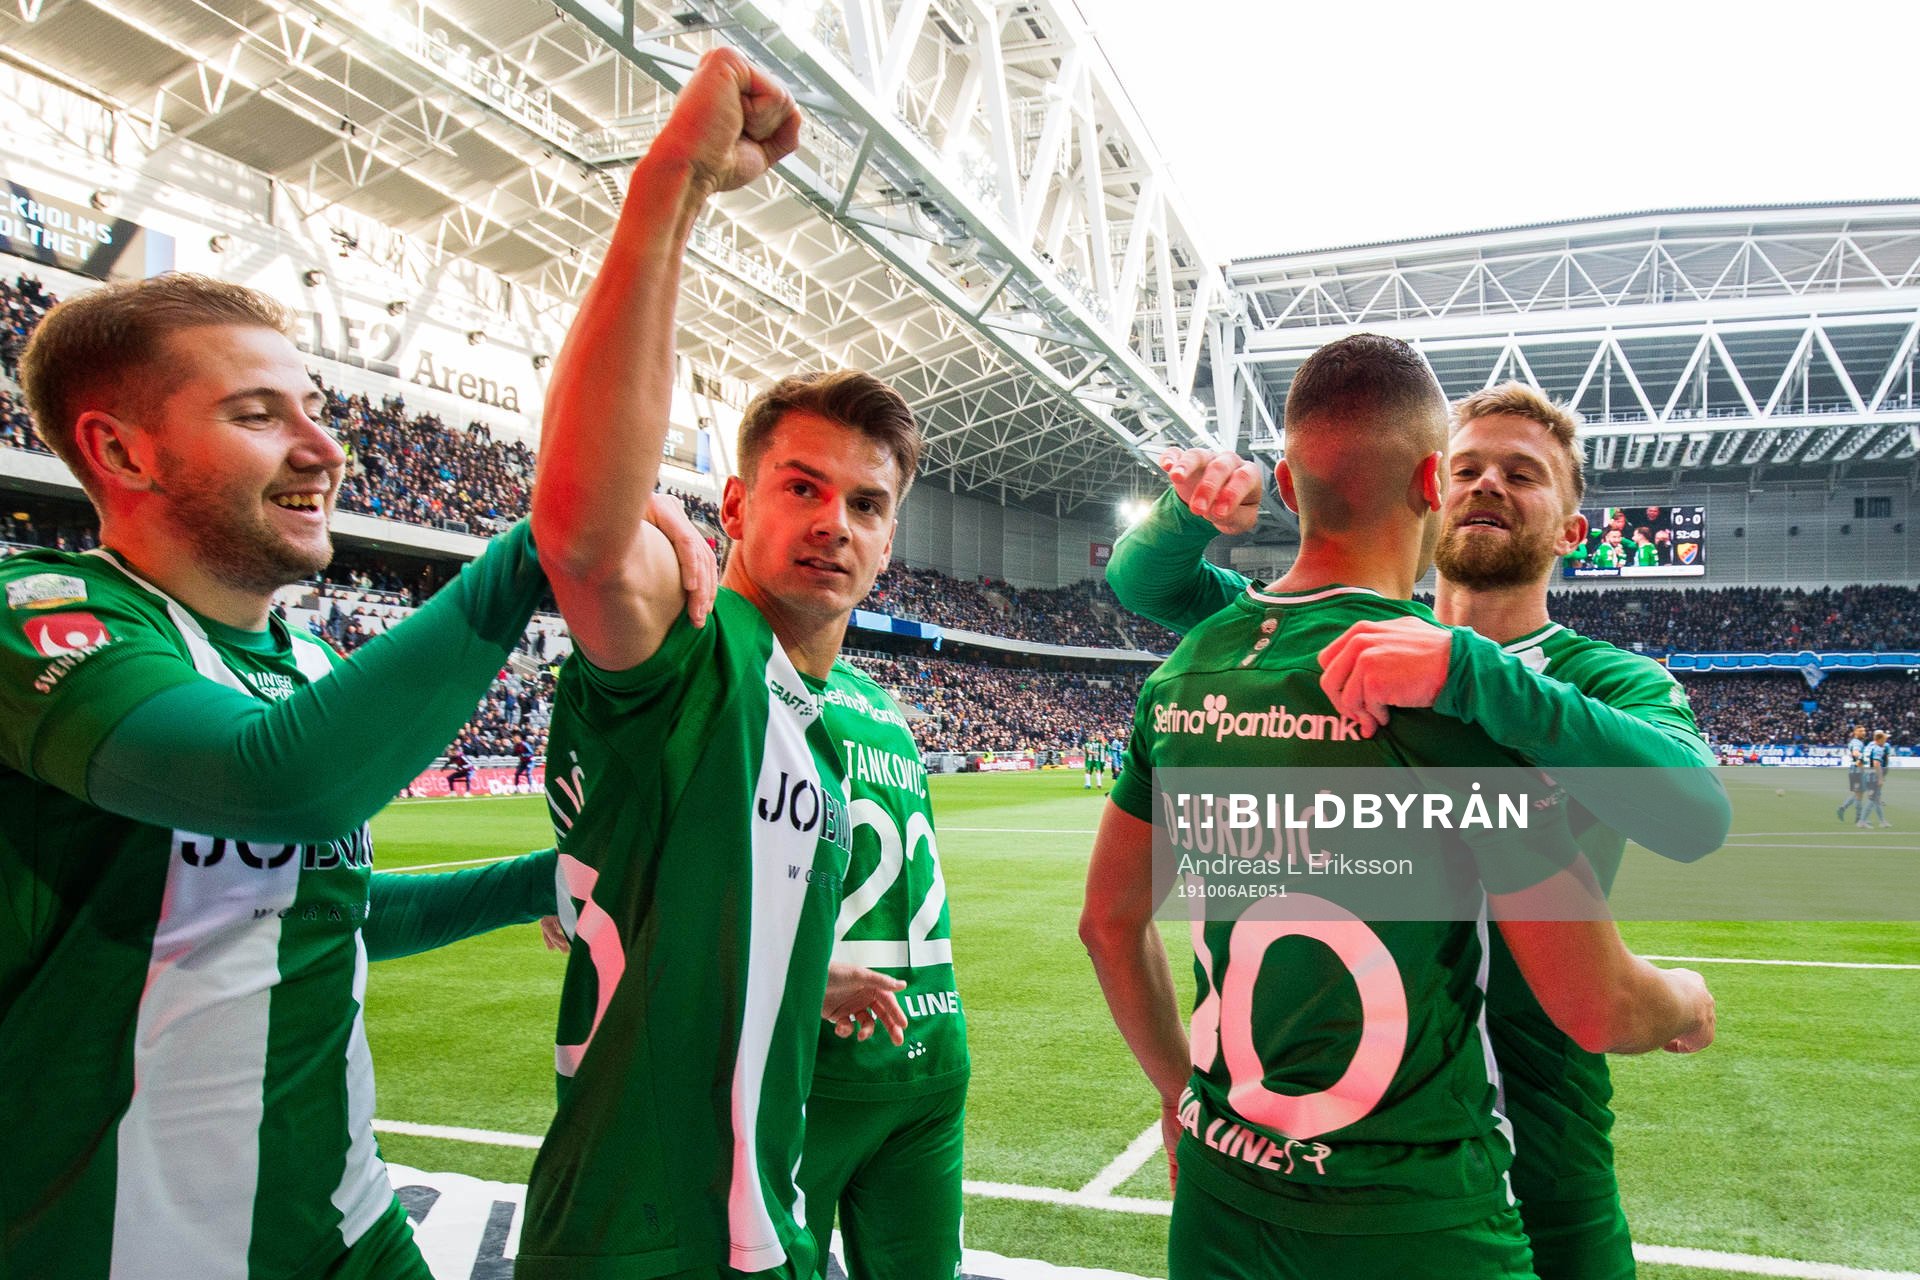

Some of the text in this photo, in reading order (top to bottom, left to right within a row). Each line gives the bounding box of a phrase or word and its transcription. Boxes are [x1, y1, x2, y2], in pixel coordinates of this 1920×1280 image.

[410, 350, 521, 413] Arena
[770, 680, 806, 711] CRAFT
[1153, 702, 1361, 743] Sefina pantbank
[831, 799, 952, 968] 22
